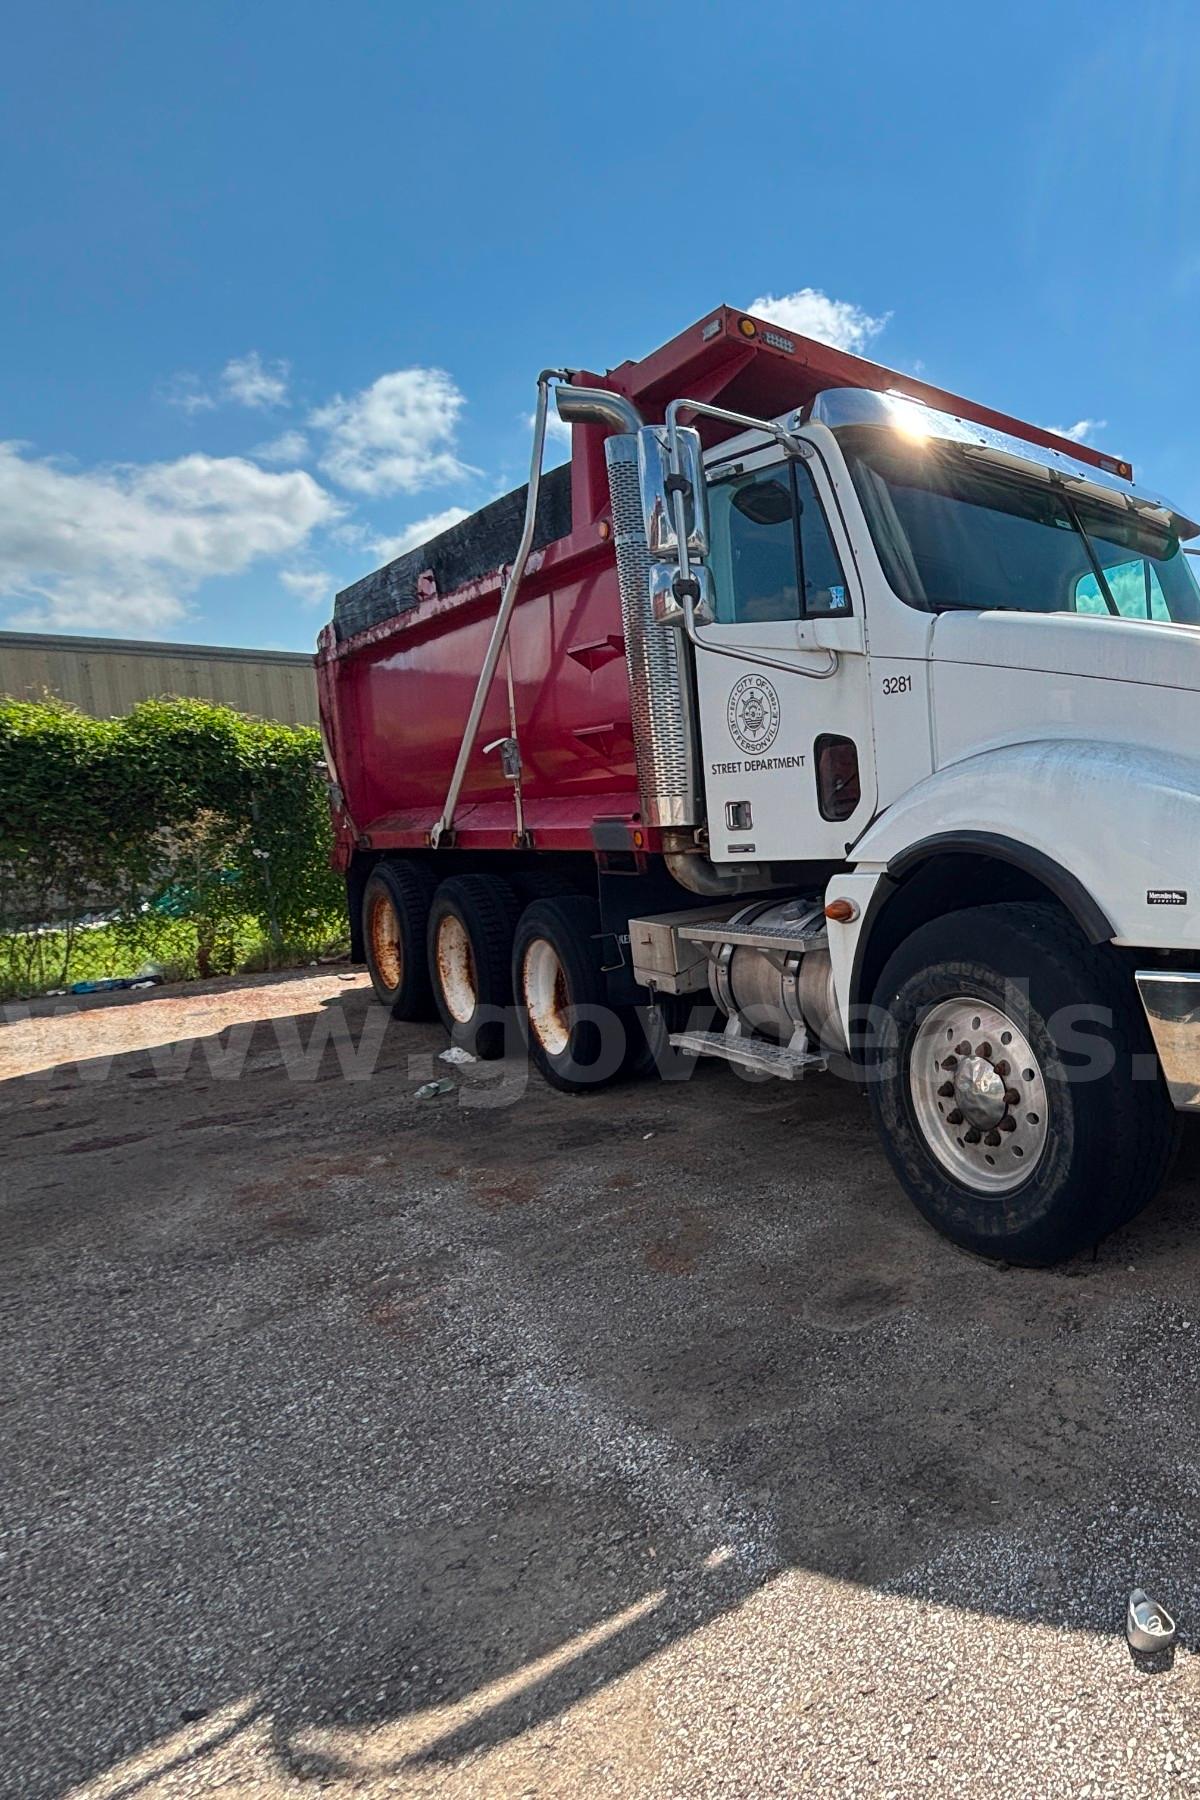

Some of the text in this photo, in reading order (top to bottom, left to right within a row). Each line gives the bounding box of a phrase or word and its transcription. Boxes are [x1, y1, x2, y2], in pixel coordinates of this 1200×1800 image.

[736, 677, 767, 693] CITY OF
[882, 674, 912, 696] 3281
[729, 711, 778, 752] JEFFERSONVILLE
[711, 755, 806, 775] STREET DEPARTMENT
